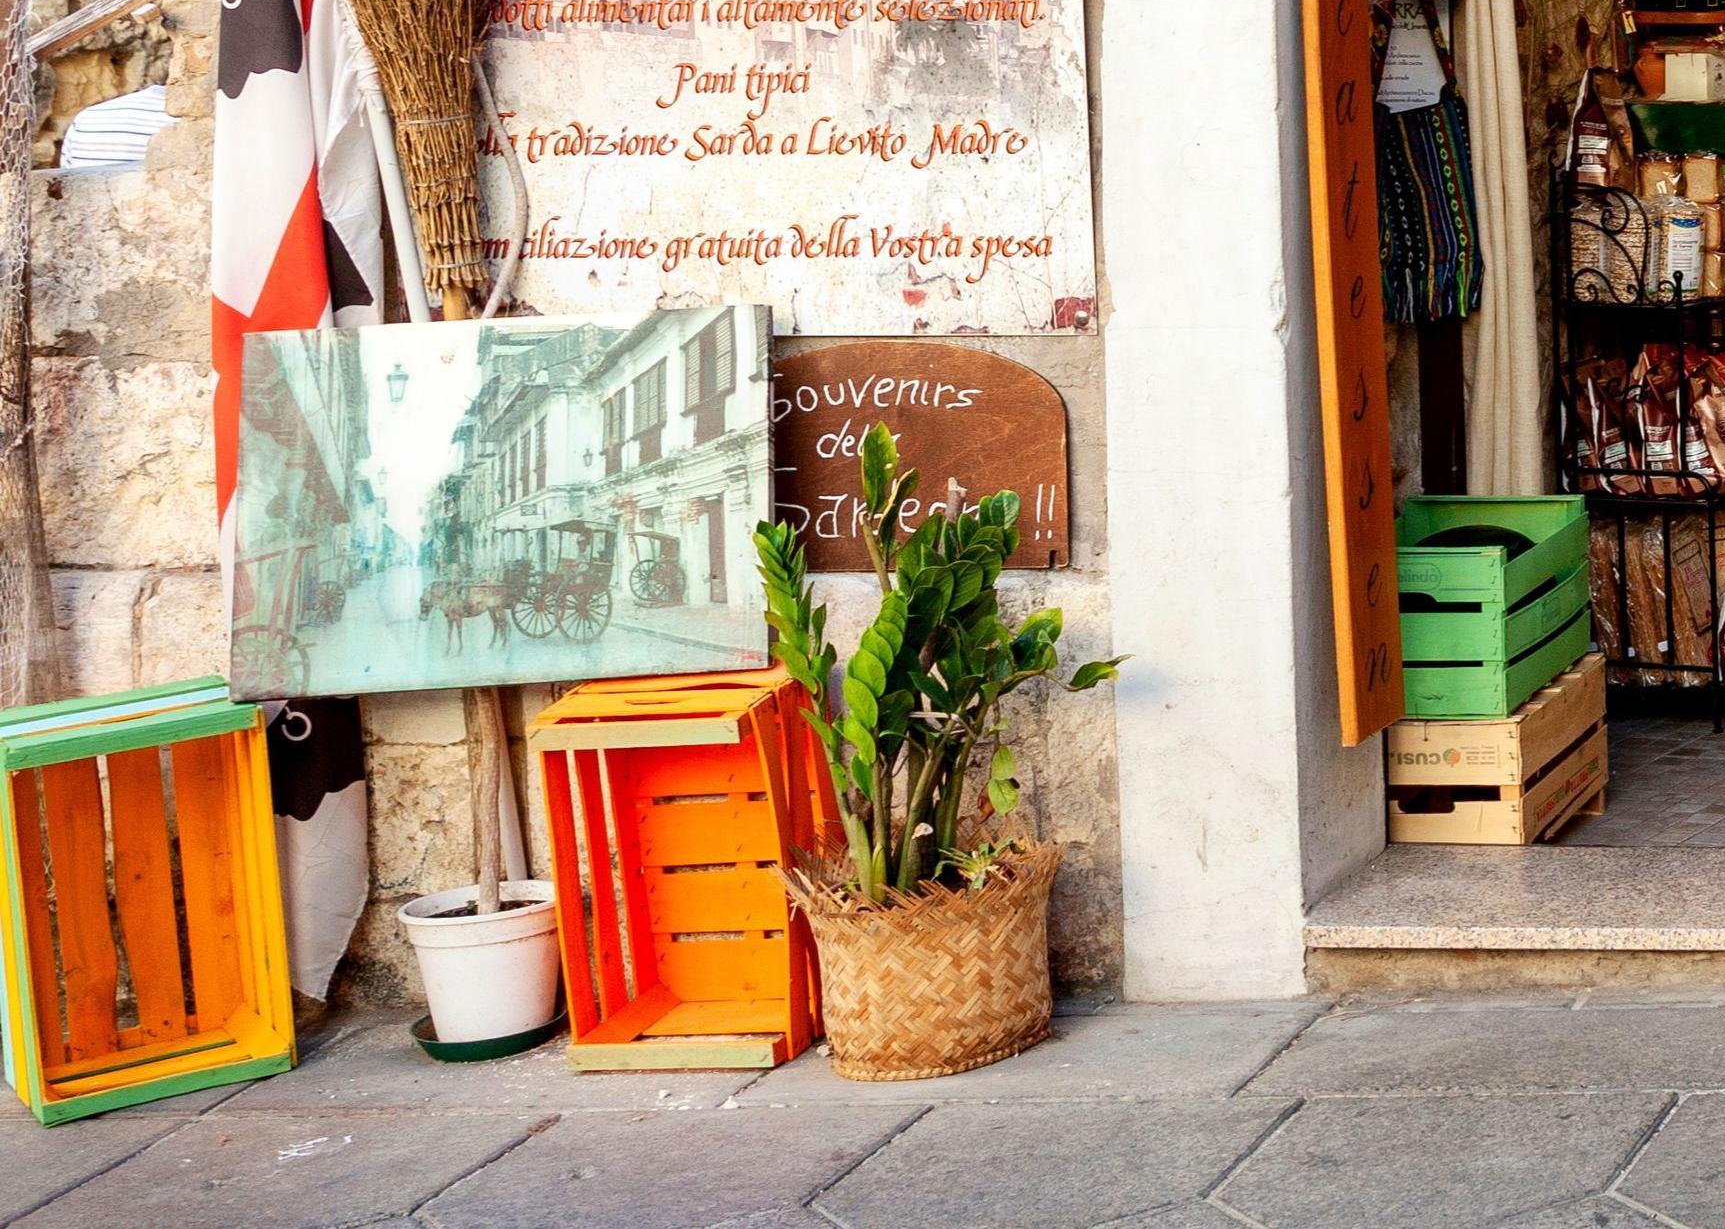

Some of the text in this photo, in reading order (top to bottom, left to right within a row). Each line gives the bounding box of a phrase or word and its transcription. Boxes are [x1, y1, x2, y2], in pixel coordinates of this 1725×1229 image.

[656, 62, 812, 121] Pani tipici
[526, 121, 678, 163] tradizione
[684, 122, 773, 161] Sarda
[781, 133, 798, 154] a
[806, 116, 906, 161] Lievito
[911, 119, 1028, 169] Madre
[662, 228, 783, 272] gratuita
[788, 214, 861, 259] della
[870, 224, 962, 265] Vostra
[965, 234, 1053, 284] spesa
[816, 418, 901, 458] del
